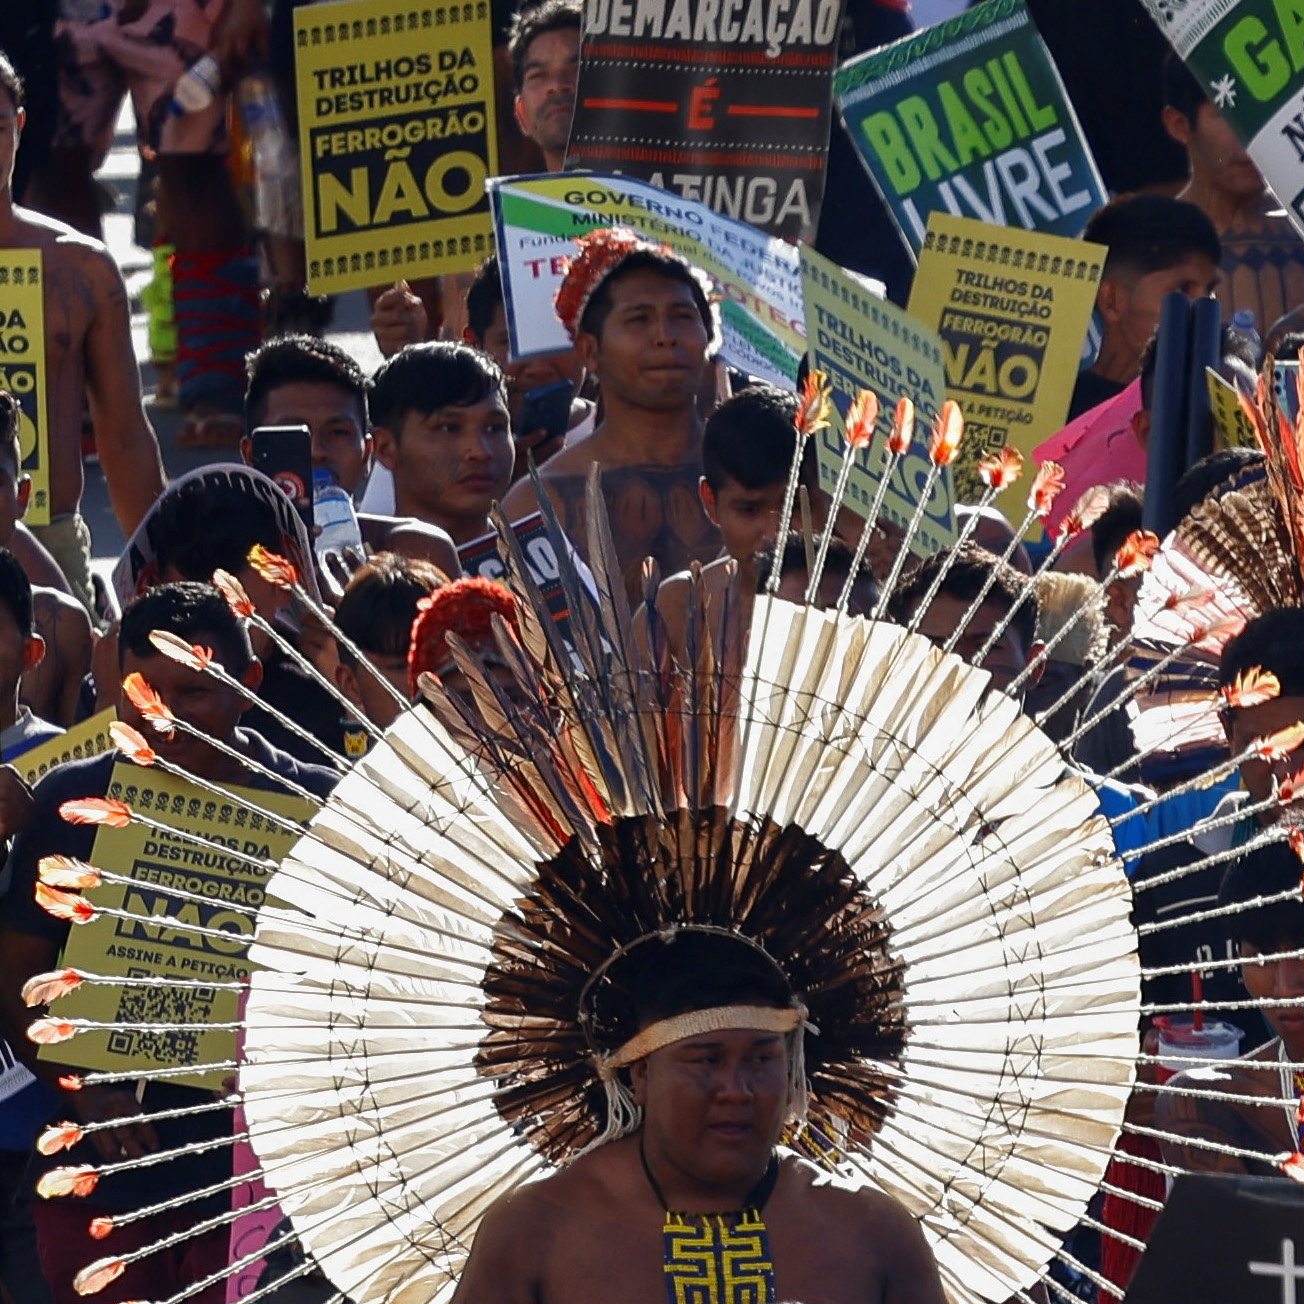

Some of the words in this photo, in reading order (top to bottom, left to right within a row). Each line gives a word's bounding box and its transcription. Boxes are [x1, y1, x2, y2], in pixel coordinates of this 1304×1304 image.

[313, 55, 432, 90] TRILHOS
[438, 47, 477, 72] DA
[314, 73, 481, 118] DESTRUIÇÃO
[687, 77, 721, 130] É
[315, 111, 486, 158] FERROGRÃO
[861, 50, 1059, 196] BRASIL
[318, 150, 489, 232] NÃO
[564, 189, 705, 225] GOVERNO
[572, 210, 701, 242] MINISTÉRIO
[951, 288, 1052, 318] DESTRUIÇÃO
[956, 269, 1028, 296] TRILHOS
[1031, 284, 1054, 301] DA
[943, 311, 1048, 348] FERROGRÃO
[814, 304, 901, 375] TRILHOS
[907, 361, 935, 398] DA
[979, 404, 1033, 425] PETIÇÃO
[243, 840, 271, 860] DA
[135, 866, 265, 906] FERROGRÃO
[106, 944, 162, 964] ASSINE
[166, 954, 177, 967] A
[180, 957, 248, 980] PETIÇÃO
